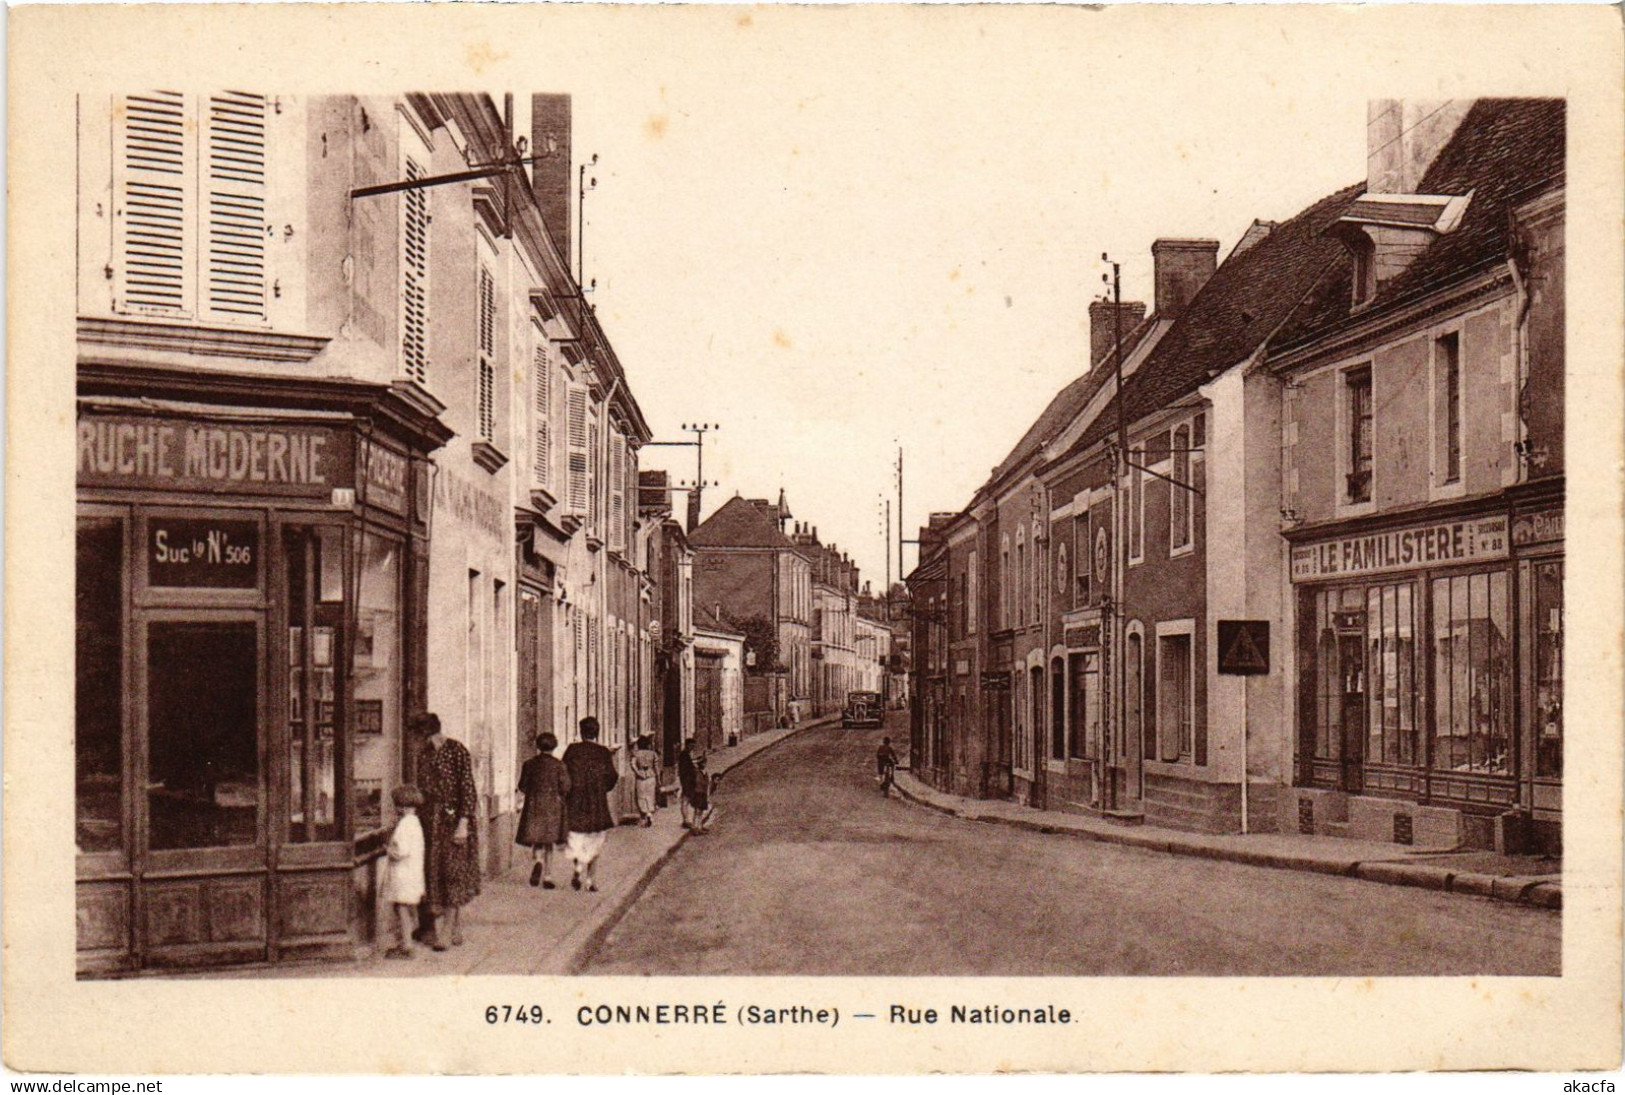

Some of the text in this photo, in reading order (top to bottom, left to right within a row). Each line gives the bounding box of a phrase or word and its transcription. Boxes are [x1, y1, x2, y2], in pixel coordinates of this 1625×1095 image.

[77, 421, 326, 484] RUCHE MODERNE
[1320, 543, 1338, 574] LE
[1343, 524, 1465, 571] FAMILISTERE
